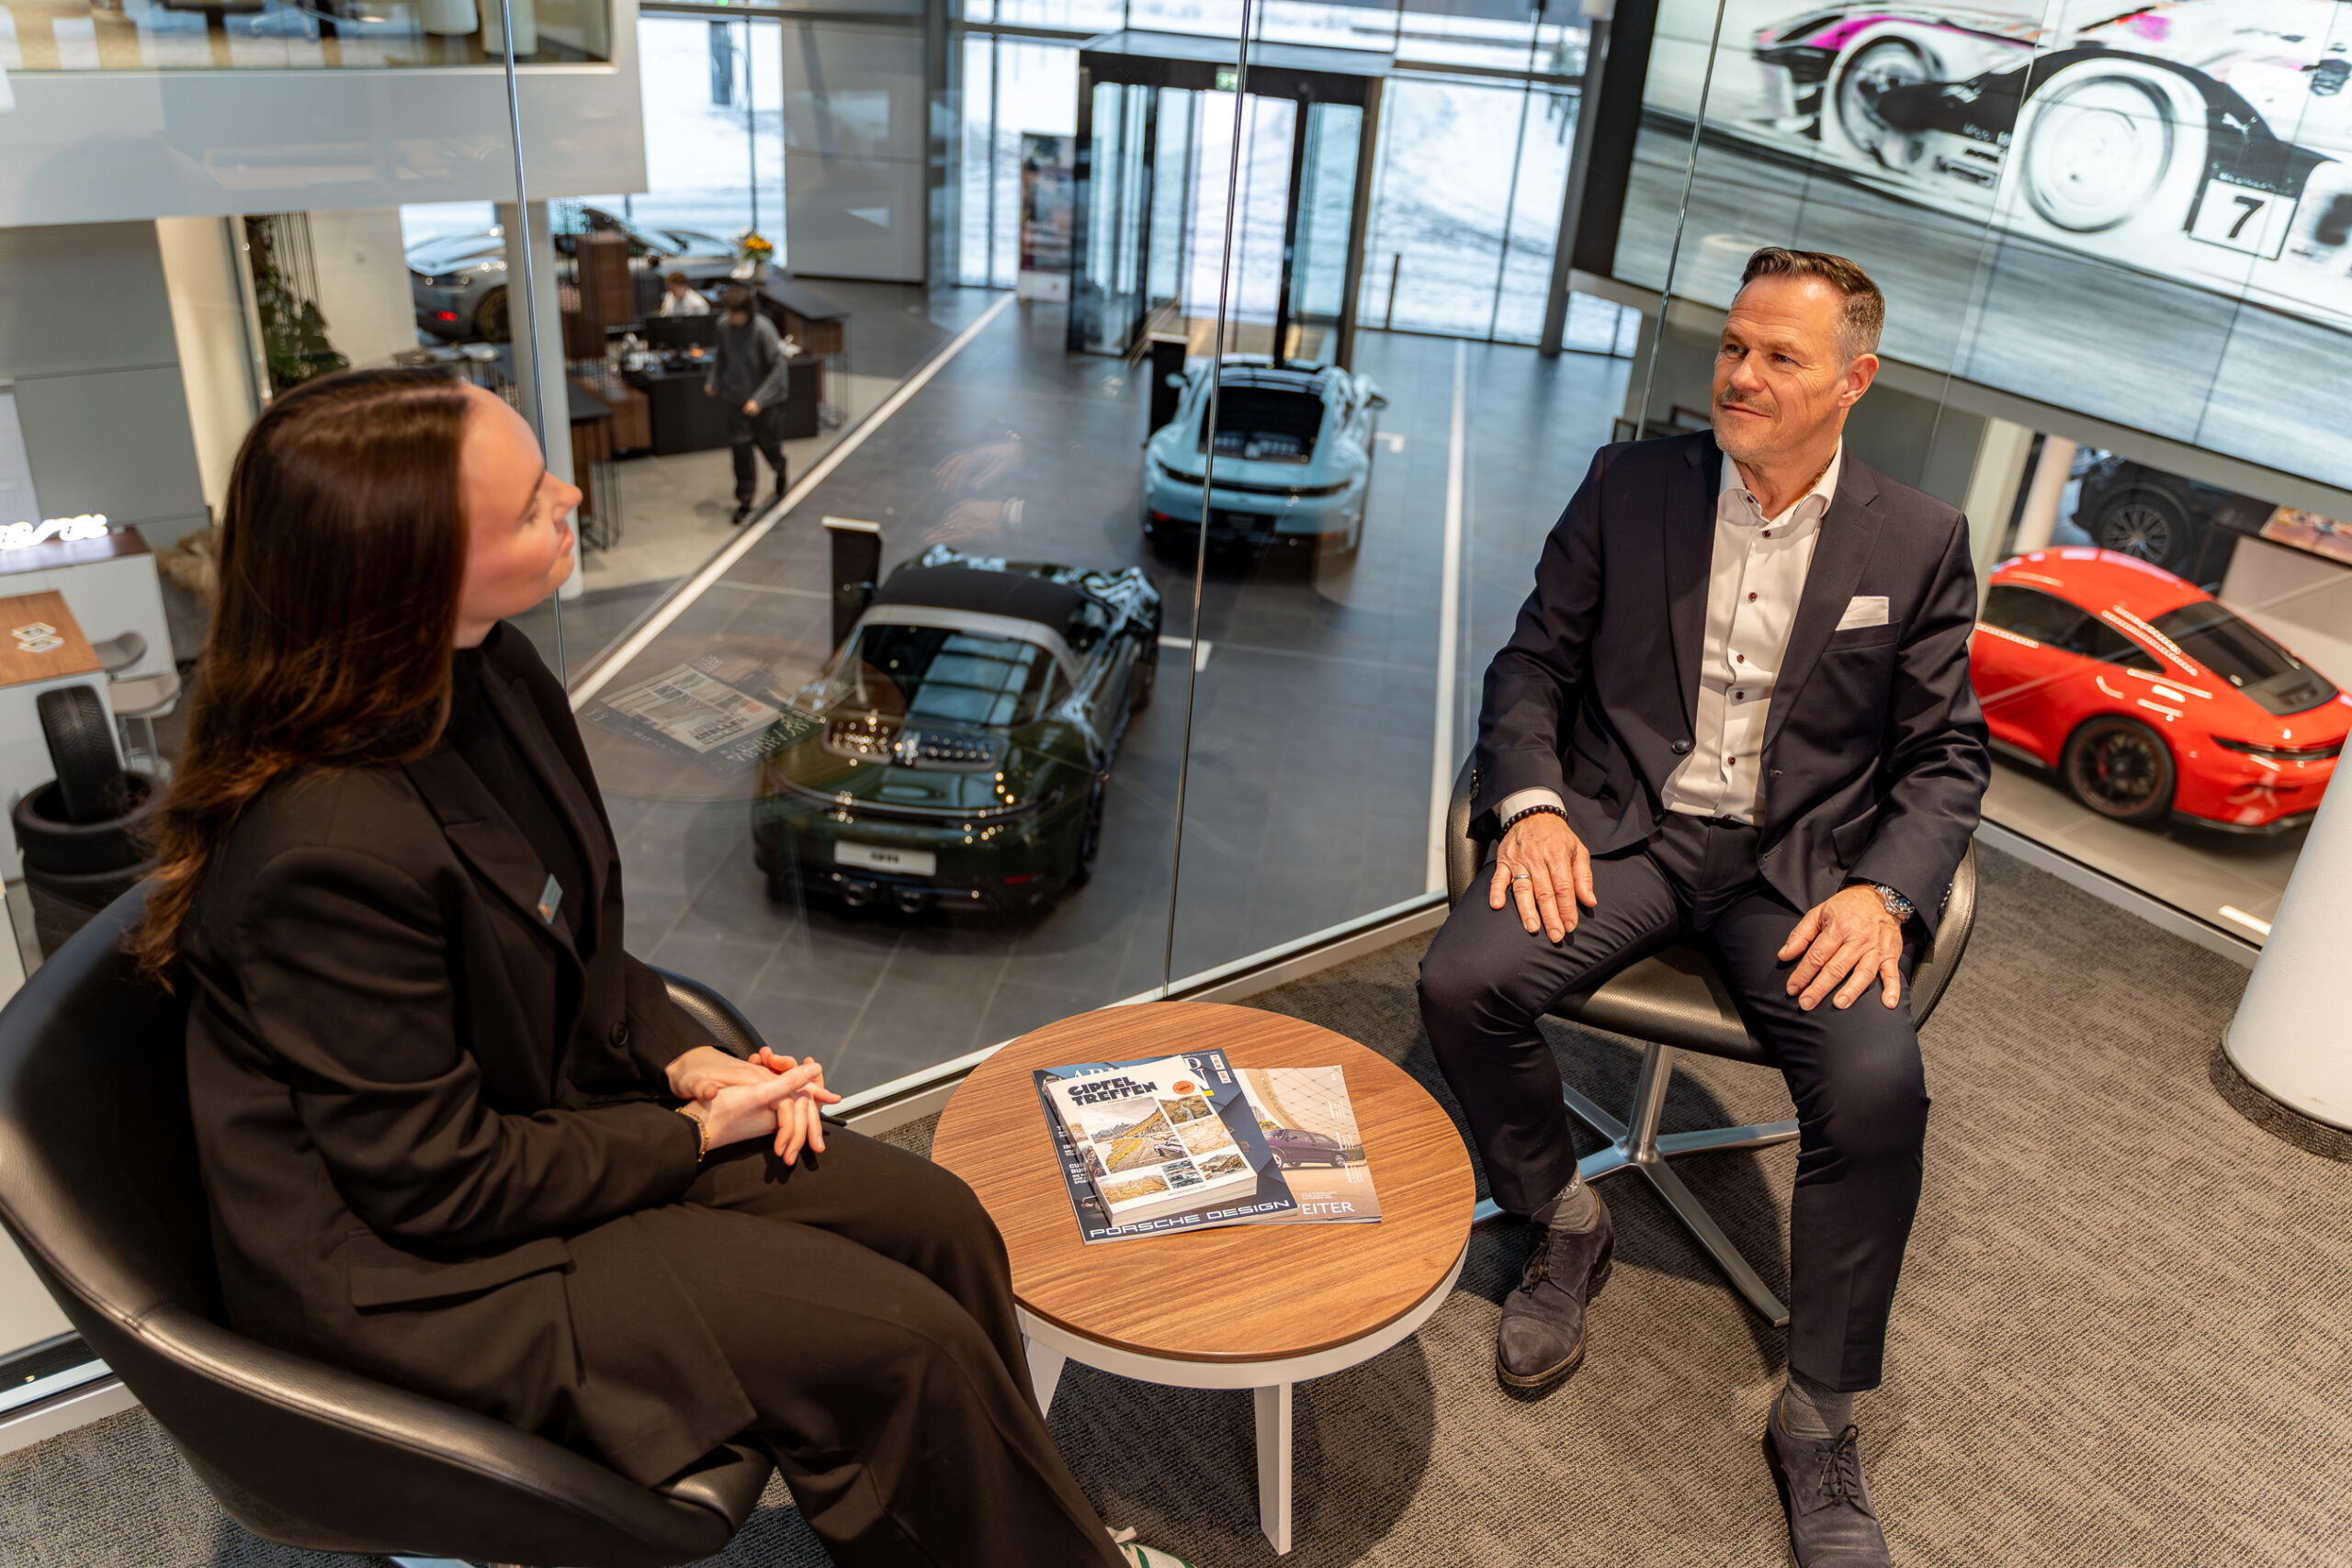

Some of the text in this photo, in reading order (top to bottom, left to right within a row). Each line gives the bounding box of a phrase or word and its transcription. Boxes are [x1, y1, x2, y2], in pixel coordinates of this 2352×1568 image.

[2228, 196, 2265, 239] 7
[1068, 1077, 1136, 1096] GIPFEL
[1071, 1081, 1158, 1107] TREFFEN
[1090, 1200, 1290, 1238] PORSCHE DESIGN
[1297, 1201, 1356, 1215] EITER
